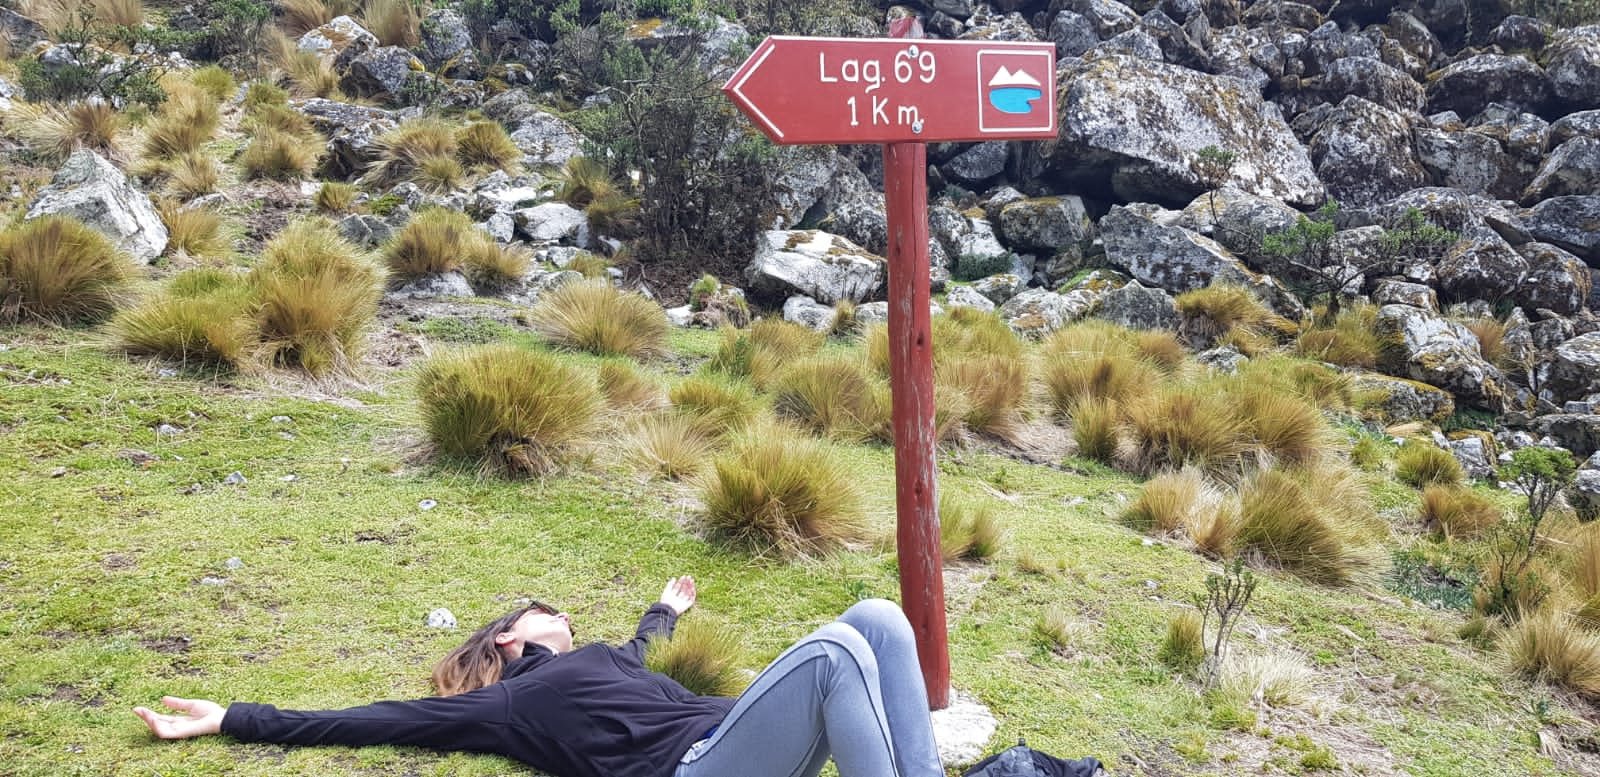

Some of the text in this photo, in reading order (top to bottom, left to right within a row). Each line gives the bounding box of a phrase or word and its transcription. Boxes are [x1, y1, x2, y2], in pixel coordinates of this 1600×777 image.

[819, 50, 936, 94] Lag. 69
[847, 95, 924, 126] 1 Km.
